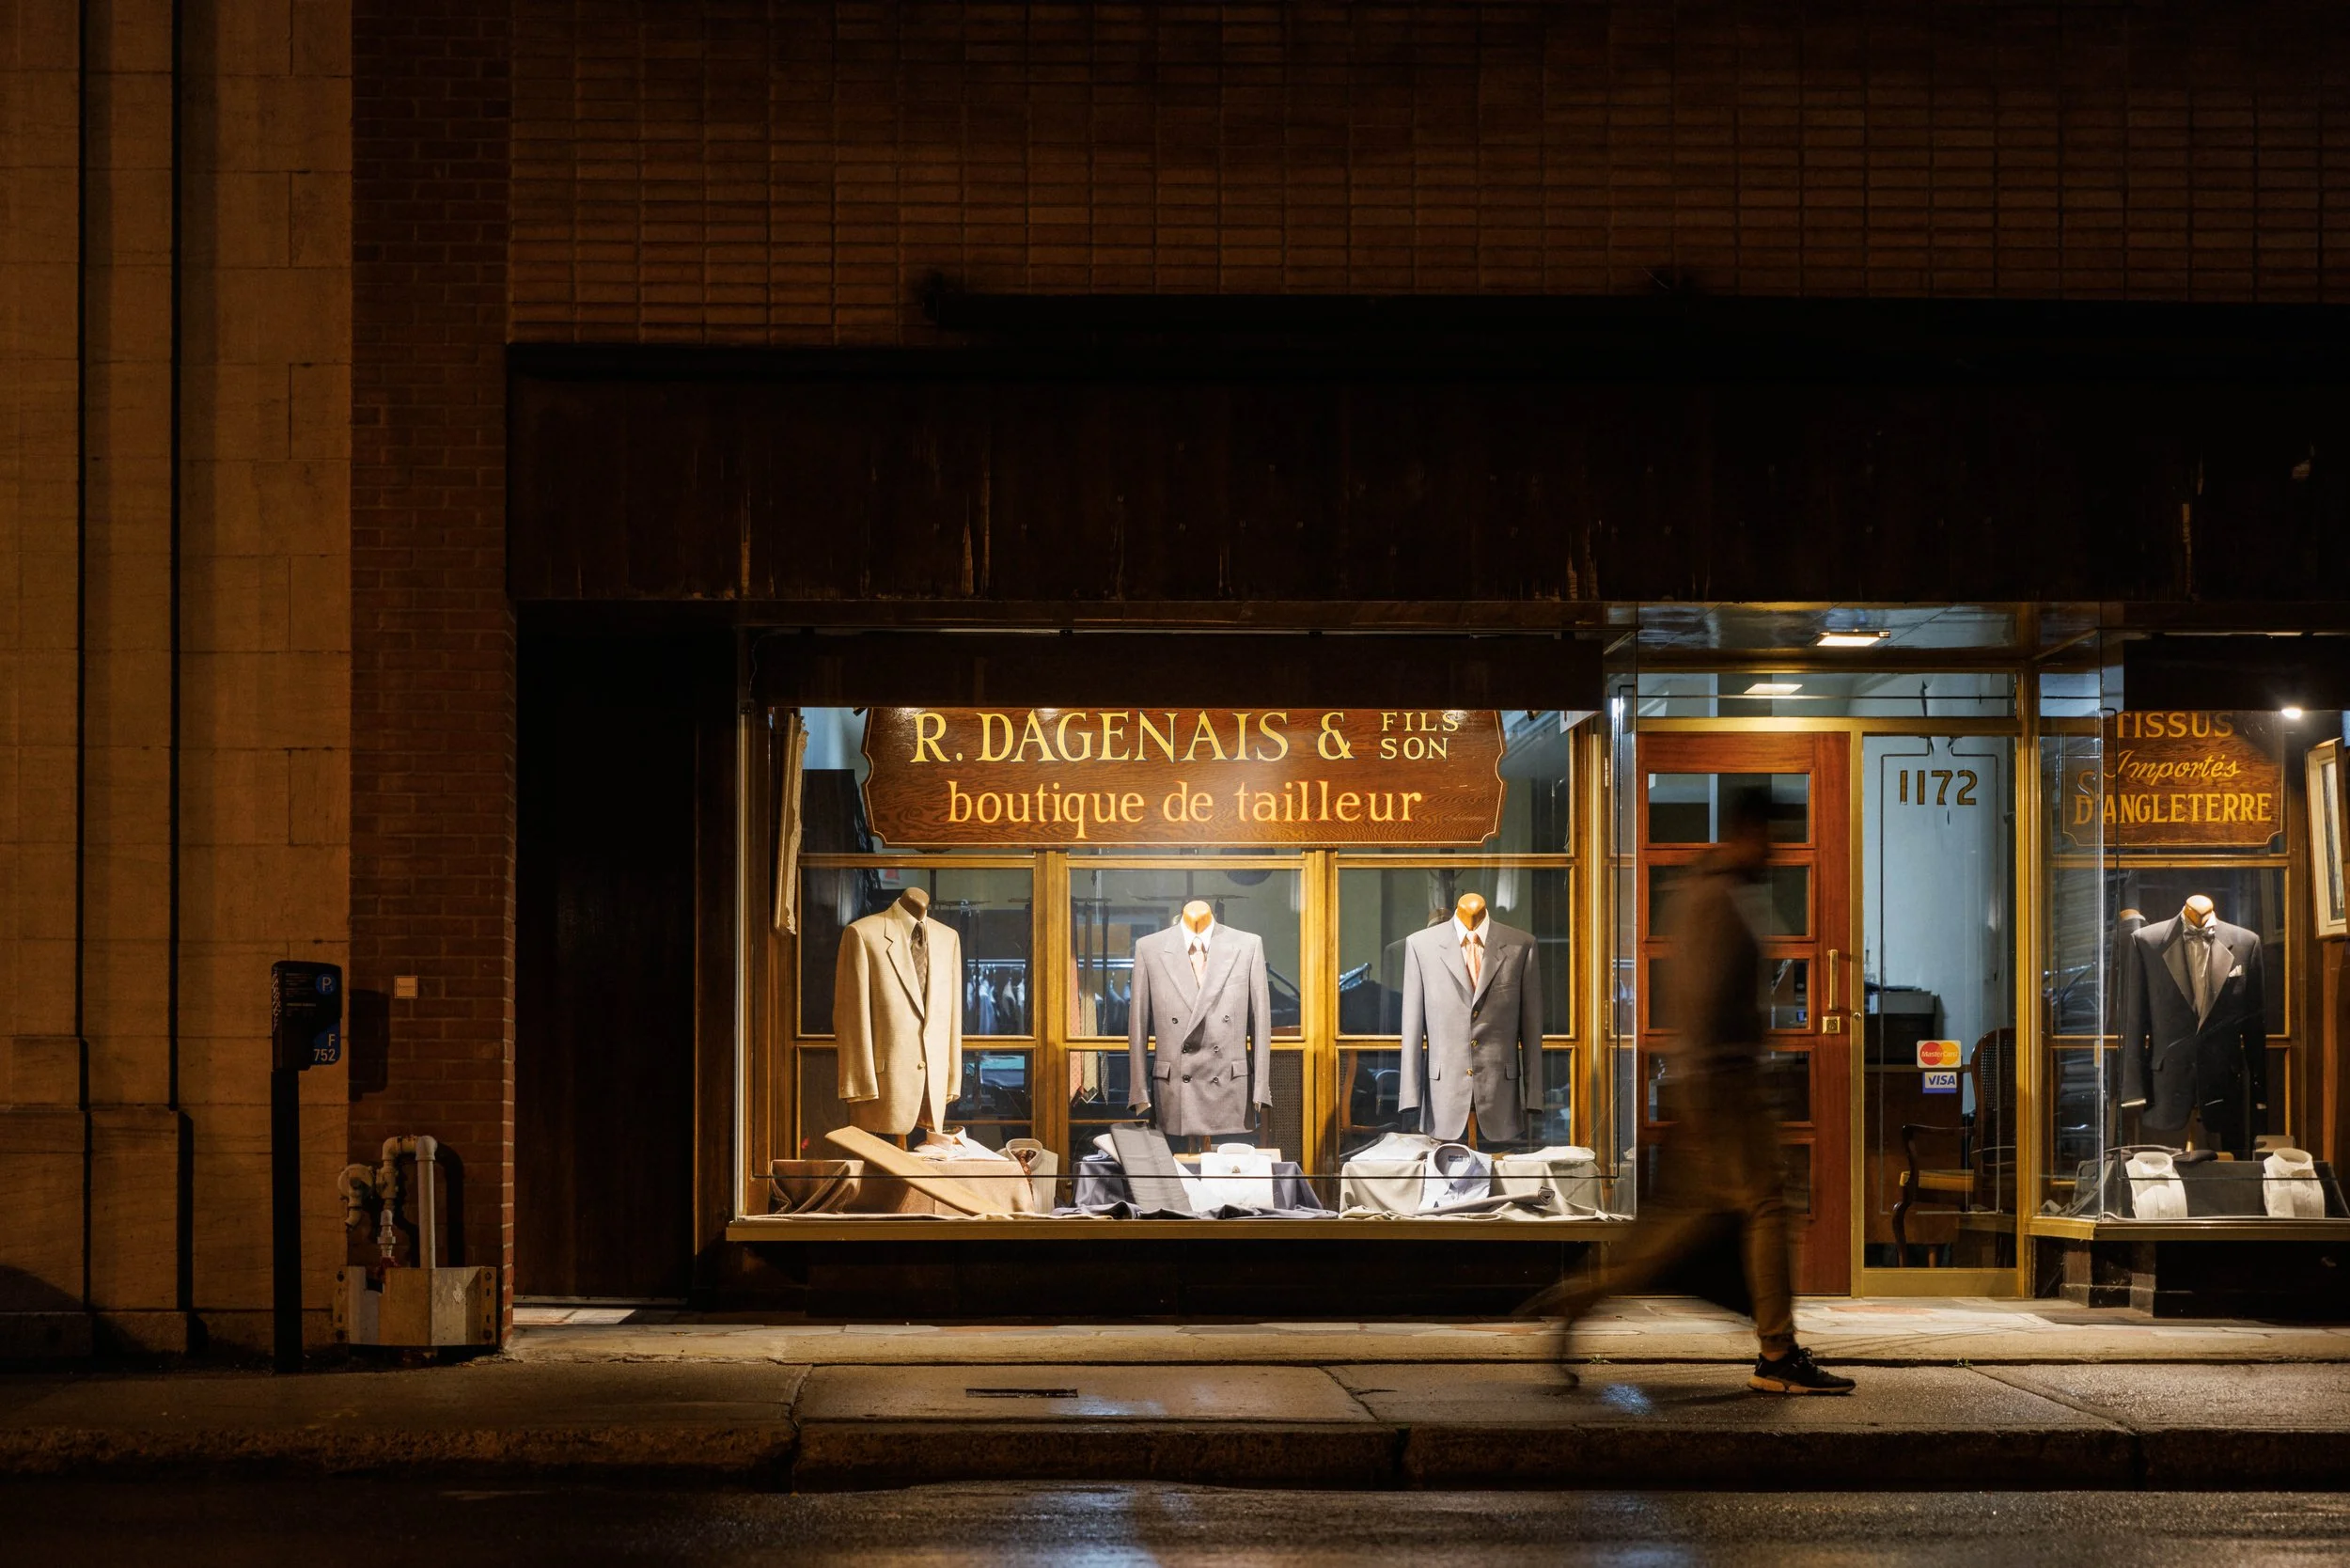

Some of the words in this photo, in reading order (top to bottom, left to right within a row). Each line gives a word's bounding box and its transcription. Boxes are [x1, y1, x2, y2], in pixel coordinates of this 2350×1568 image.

[1380, 712, 1460, 732] FILS
[2115, 712, 2233, 739] TISSUS
[910, 712, 964, 763] R.
[975, 709, 1290, 763] DAGENAIS
[1317, 711, 1355, 760] &
[1380, 737, 1449, 760] SON
[2103, 749, 2241, 787] Importés
[1900, 769, 1978, 806] 1172
[947, 779, 1145, 839] boutique
[1162, 779, 1214, 823] de
[1232, 779, 1422, 823] tailleur
[2072, 792, 2273, 826] D'ANGLETERRE
[327, 1033, 336, 1046] F
[313, 1048, 337, 1061] 752
[1928, 1074, 1956, 1085] VISA
